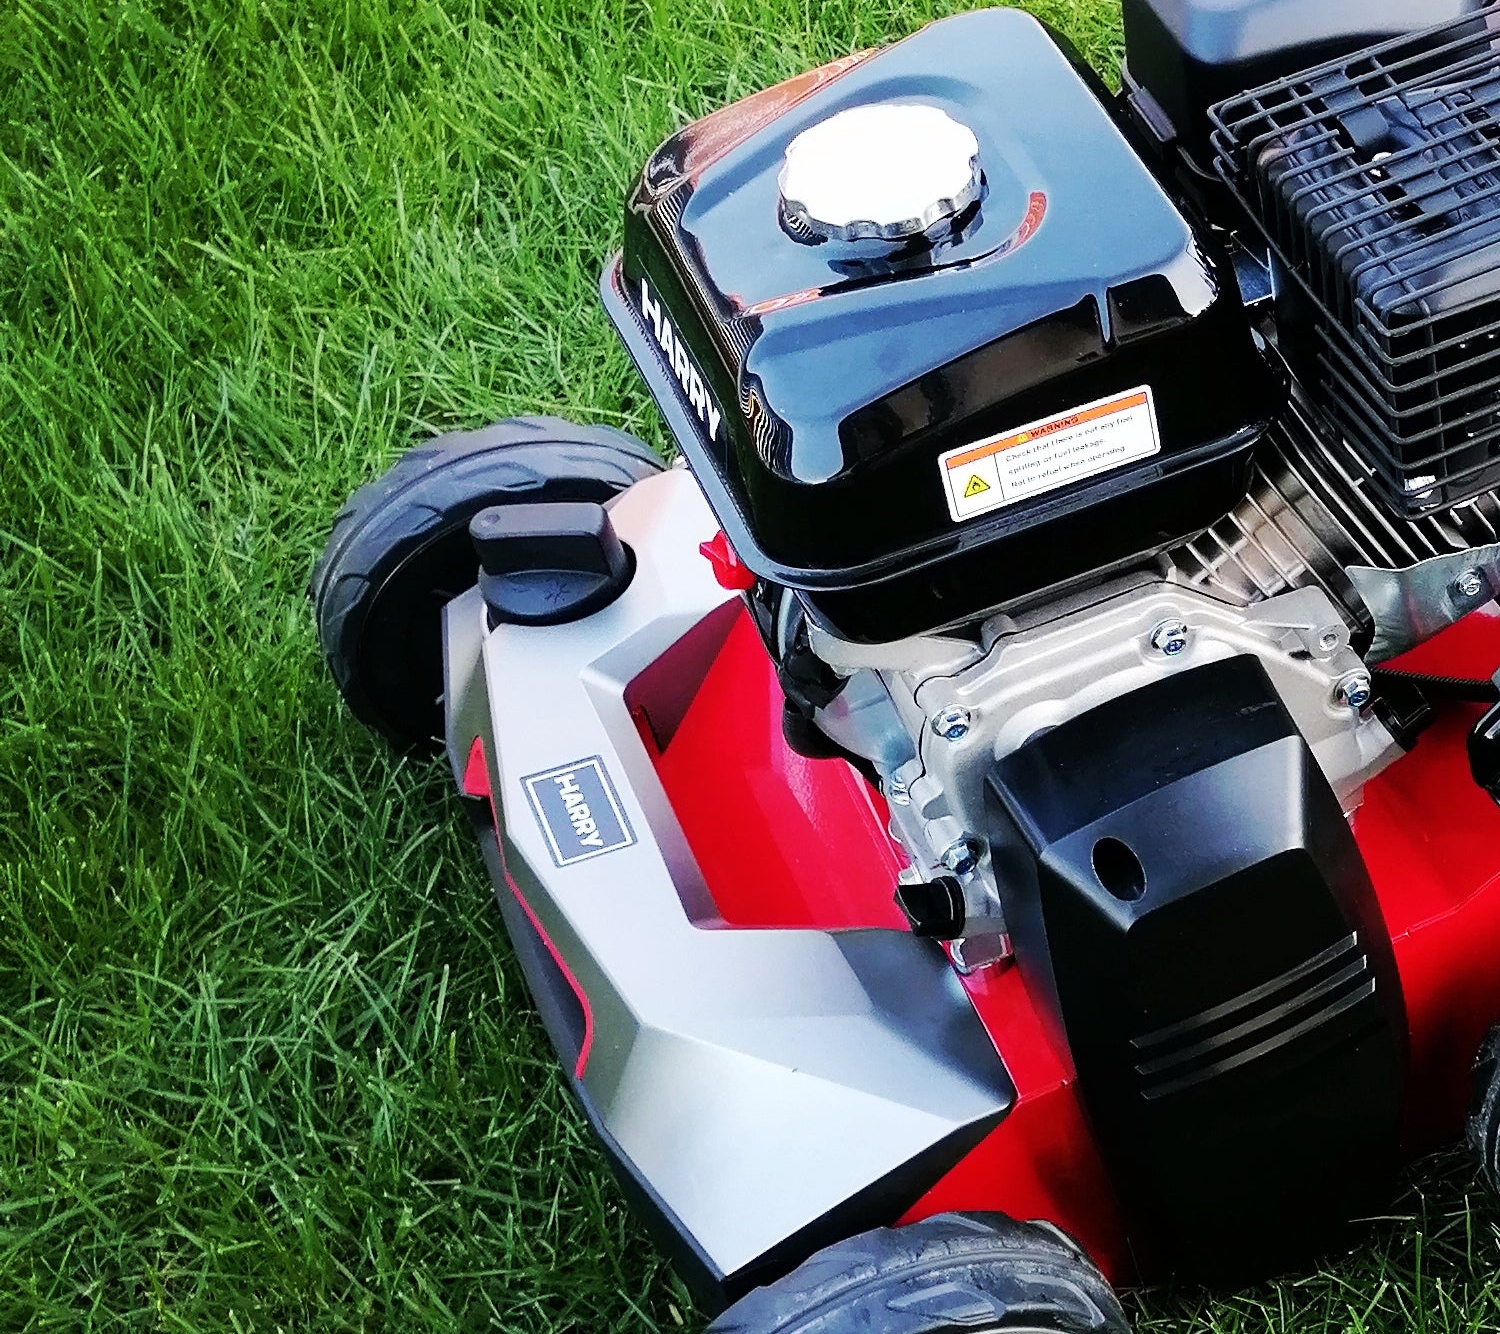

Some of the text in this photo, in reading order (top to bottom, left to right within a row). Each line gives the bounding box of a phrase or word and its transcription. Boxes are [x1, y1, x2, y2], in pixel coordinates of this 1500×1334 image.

[641, 278, 721, 442] HARRY
[1030, 416, 1079, 437] WARNING
[554, 773, 604, 847] HARRY
